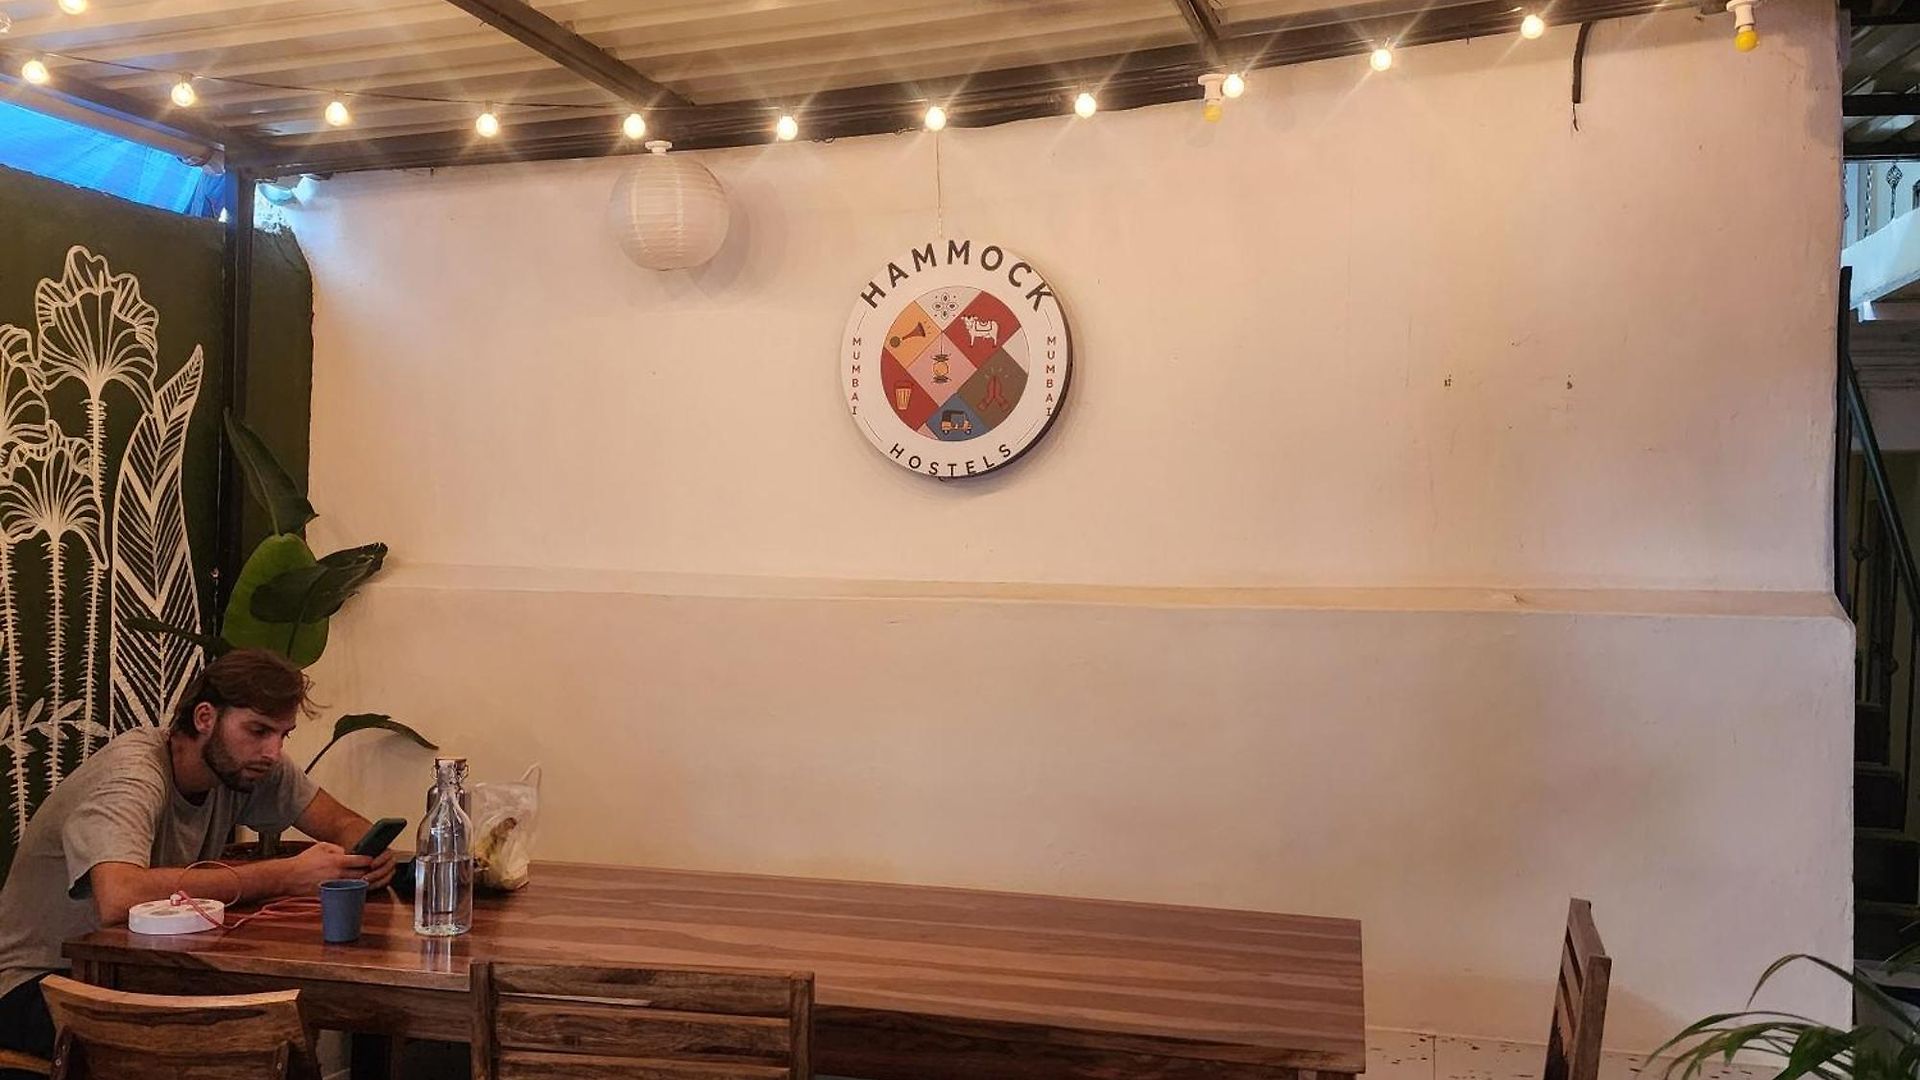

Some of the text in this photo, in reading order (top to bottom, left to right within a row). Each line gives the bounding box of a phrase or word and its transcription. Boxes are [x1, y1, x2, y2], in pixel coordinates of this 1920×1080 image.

[860, 240, 1056, 312] HAMMOCK
[851, 338, 862, 416] MUMBAI
[1045, 336, 1057, 417] MUMBAI
[889, 443, 1012, 477] HOSTELS
